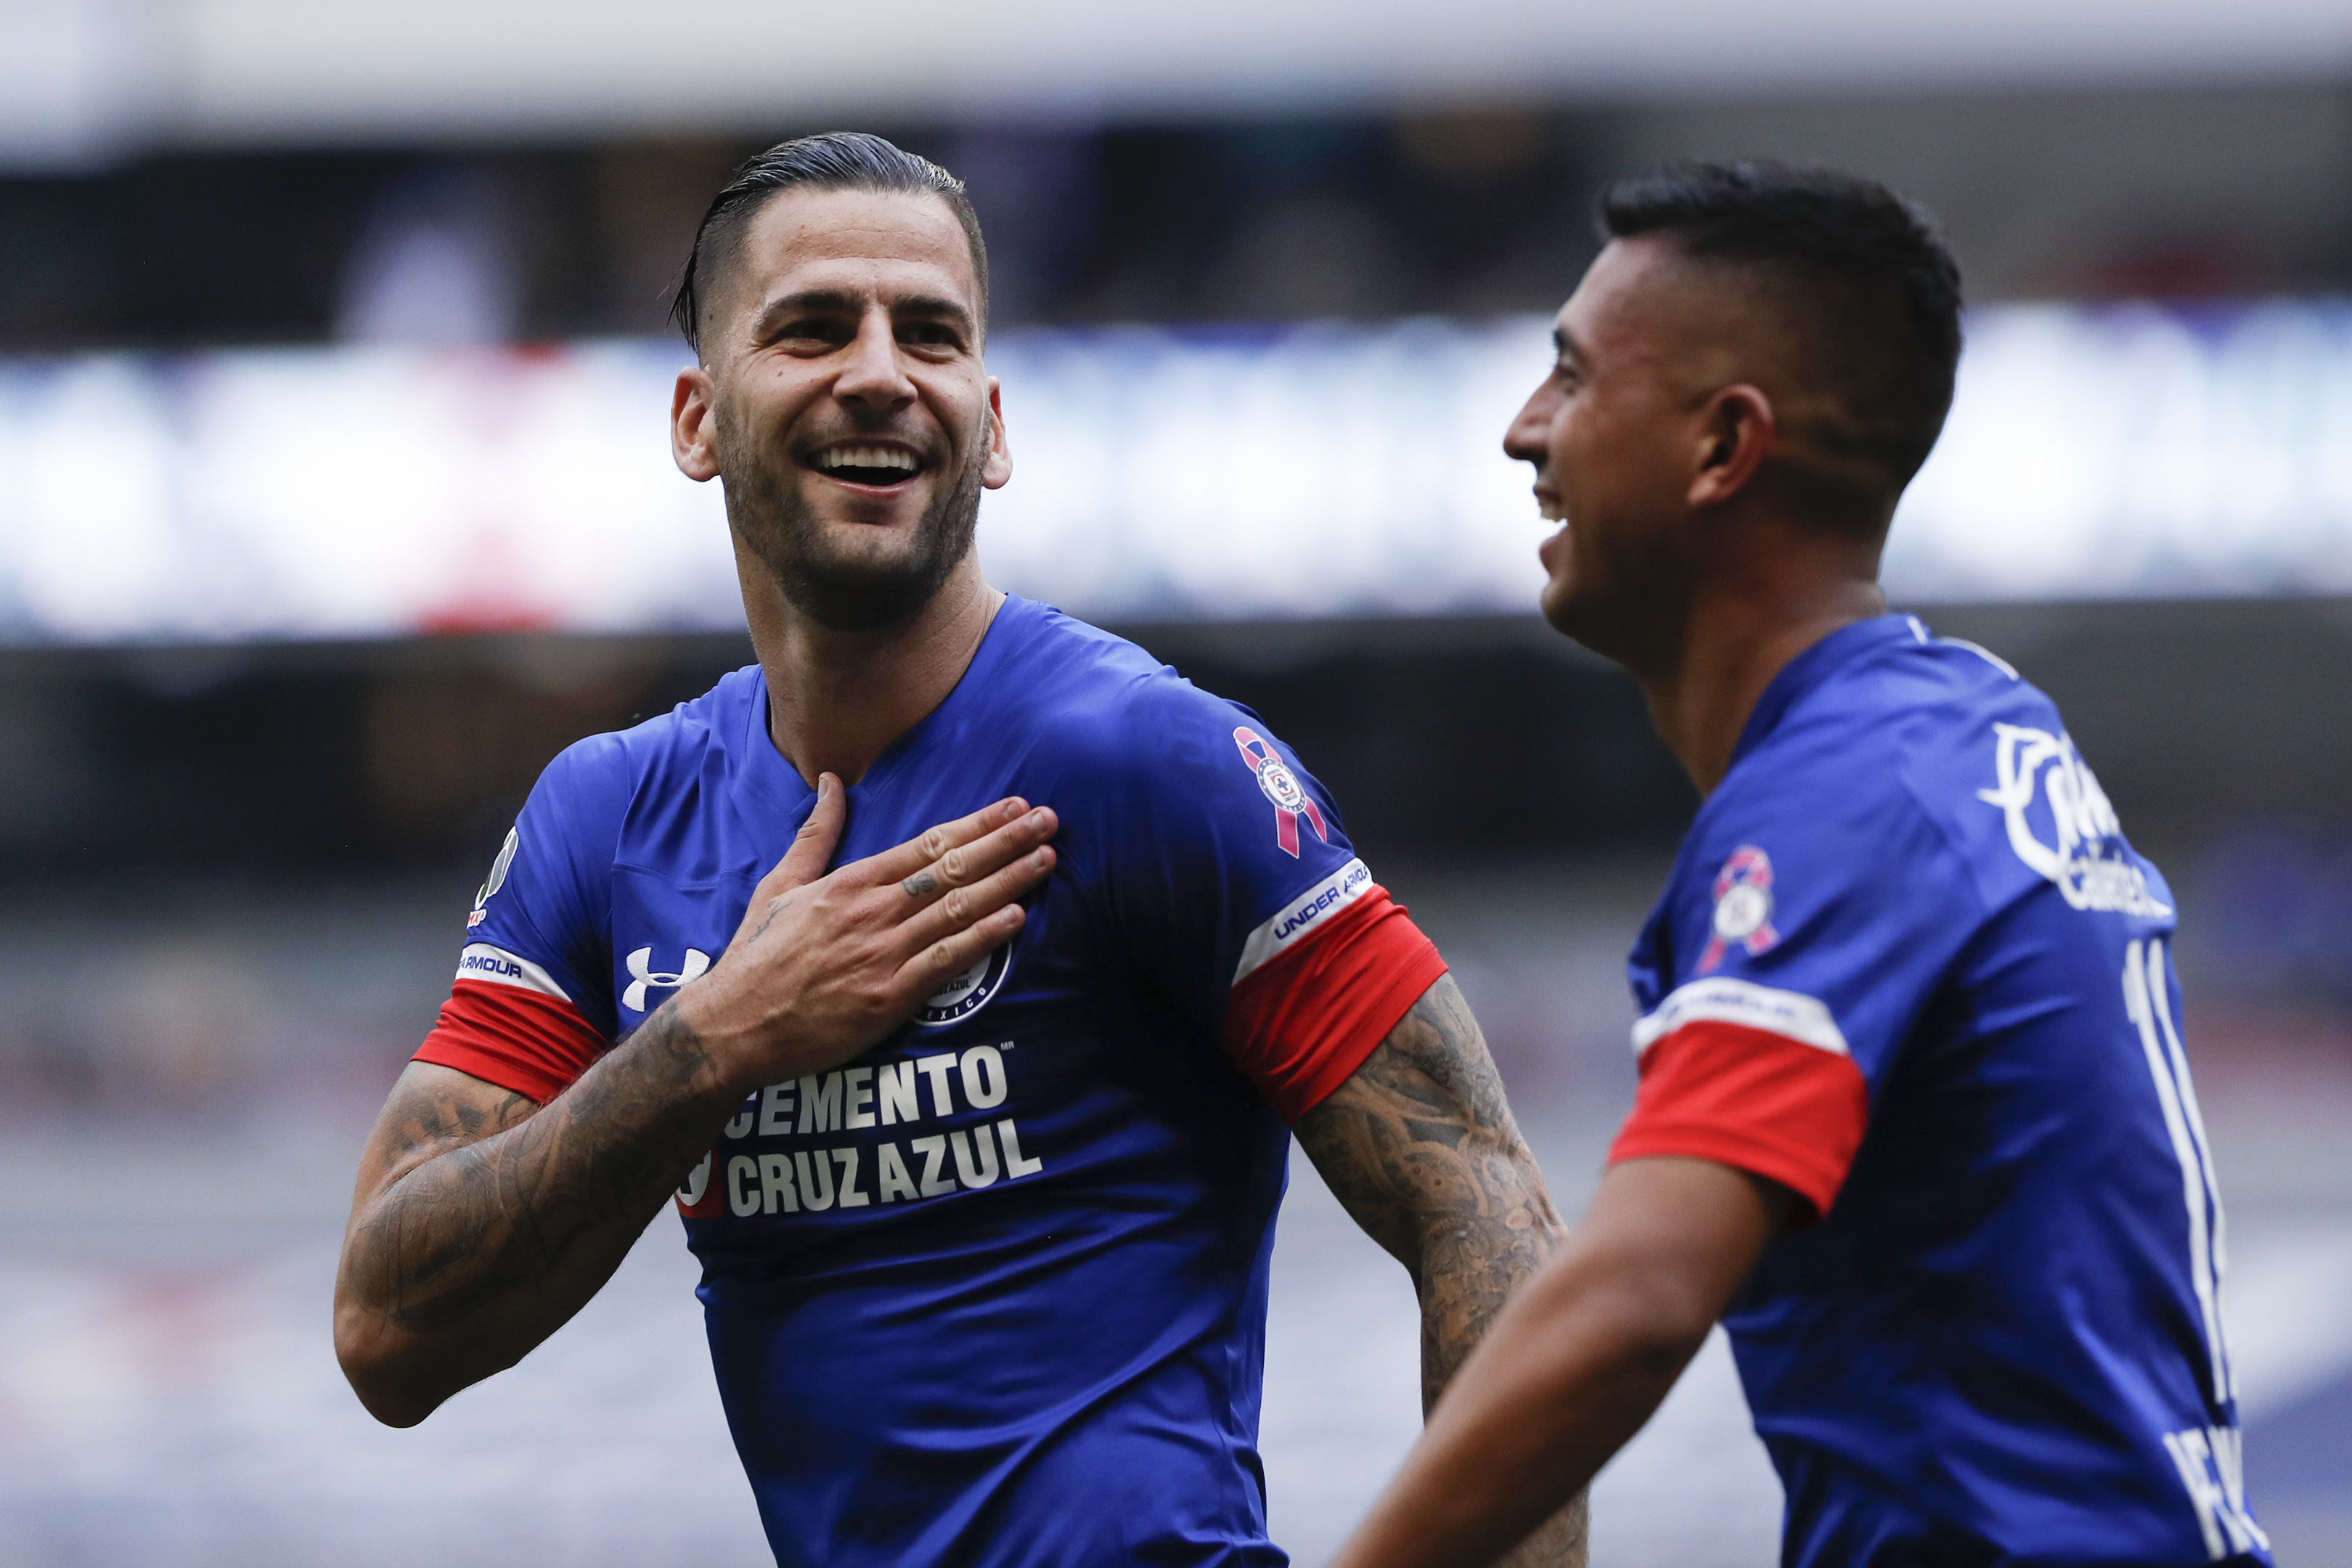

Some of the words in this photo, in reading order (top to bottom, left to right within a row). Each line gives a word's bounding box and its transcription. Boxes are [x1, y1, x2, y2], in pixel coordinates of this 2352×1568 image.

[1274, 886, 1340, 939] UNDER
[1344, 865, 1369, 894] ARMOU
[926, 987, 987, 1021] EXICO
[727, 1147, 870, 1217] CRUZ
[878, 1119, 1043, 1204] AZUL
